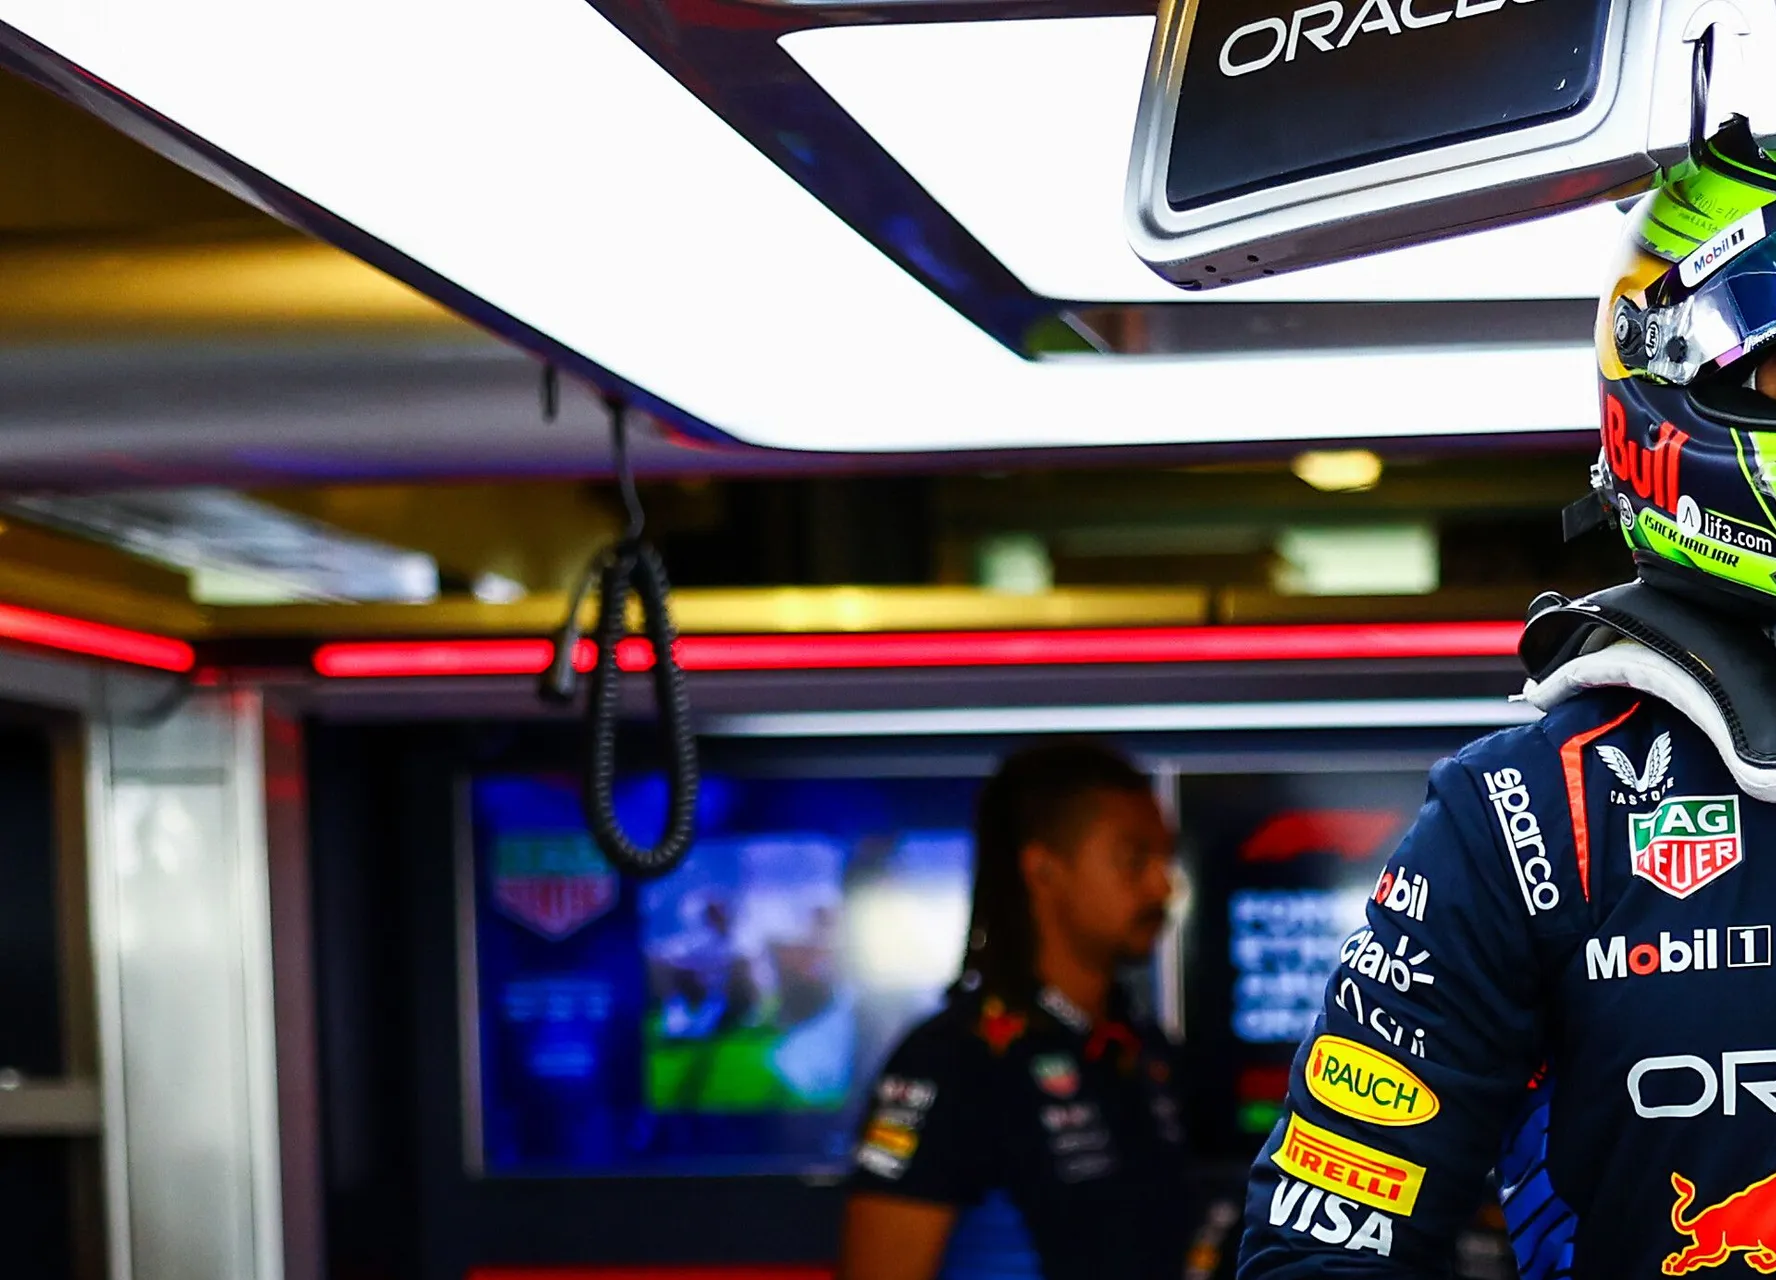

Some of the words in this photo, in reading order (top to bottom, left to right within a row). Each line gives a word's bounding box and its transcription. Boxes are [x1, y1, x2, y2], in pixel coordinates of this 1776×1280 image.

[1219, 0, 1540, 76] ORAC
[1693, 240, 1729, 274] Mobil
[1731, 228, 1745, 246] 1
[1607, 393, 1690, 515] Bull
[1644, 514, 1678, 544] ISACK
[1704, 513, 1772, 553] lif3.com
[1484, 767, 1559, 915] sparco
[1638, 802, 1728, 843] TAG
[1371, 864, 1429, 921] obil
[1585, 928, 1718, 980] Mobil
[1321, 1054, 1419, 1115] RAUCH
[1285, 1126, 1408, 1202] PIRELLI
[1268, 1174, 1394, 1258] VISA
